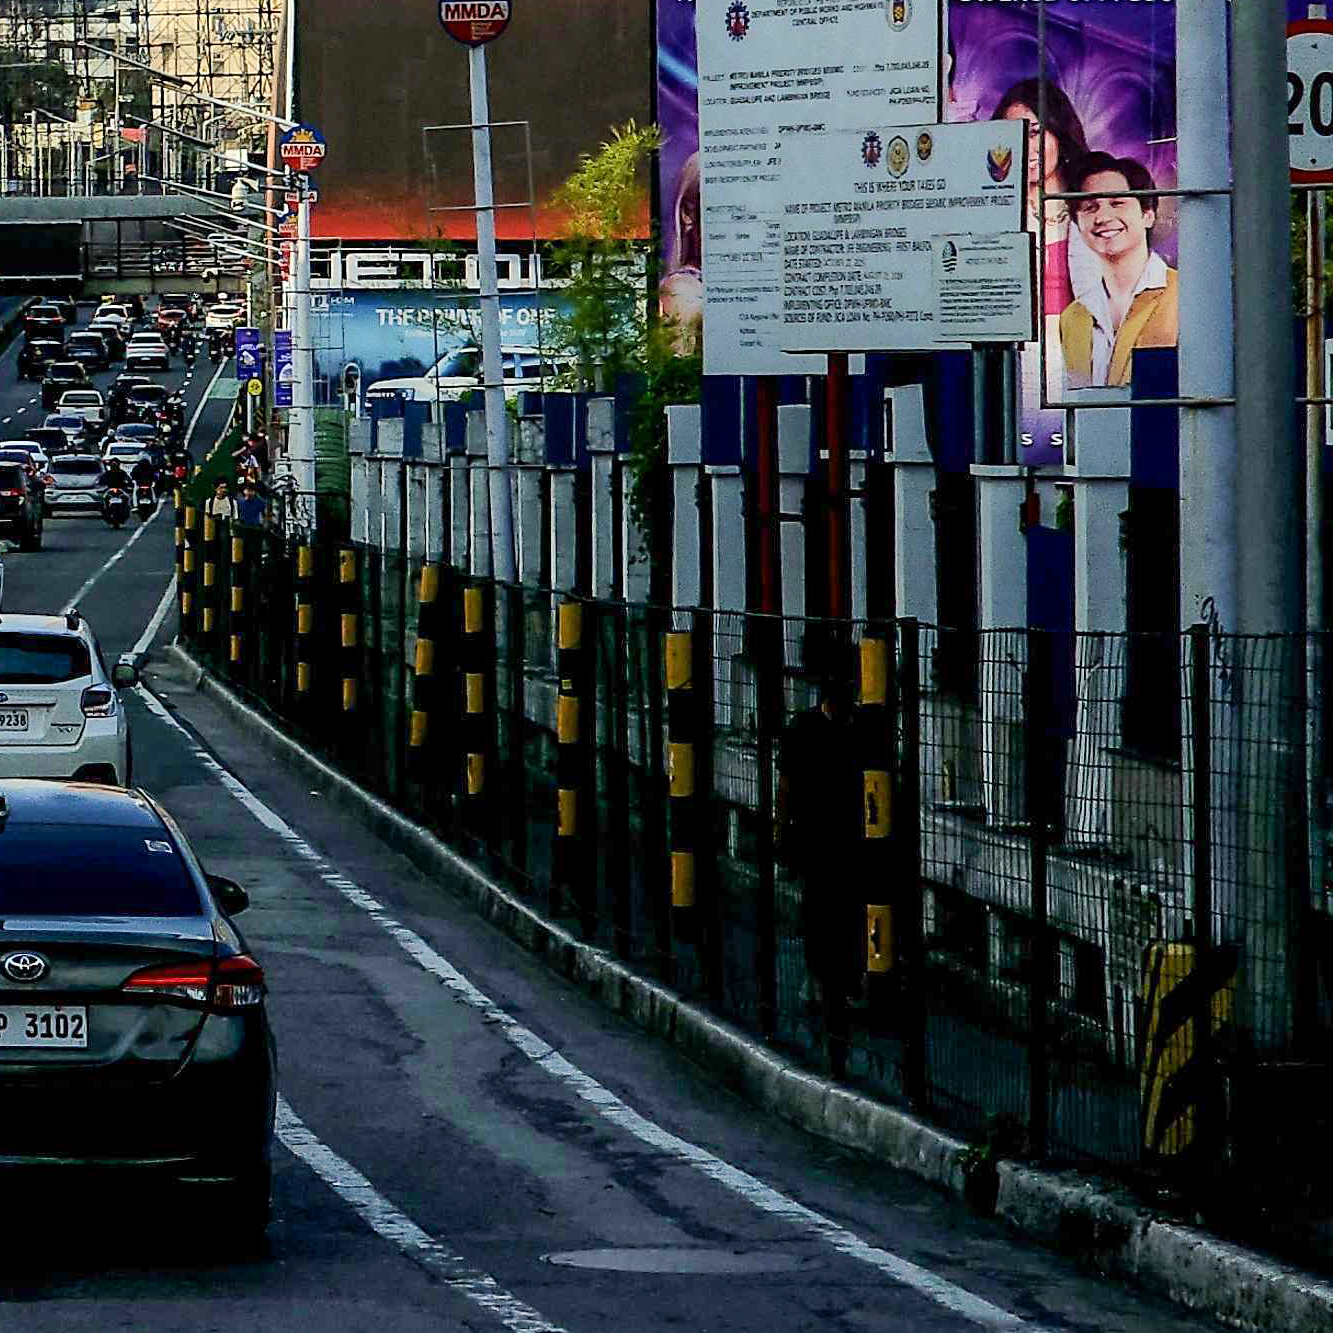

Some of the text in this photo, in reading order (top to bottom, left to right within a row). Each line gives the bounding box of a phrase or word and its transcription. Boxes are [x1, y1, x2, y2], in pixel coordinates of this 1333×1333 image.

[445, 2, 505, 20] MMDA
[283, 145, 321, 157] MMDA
[854, 181, 867, 194] THIS
[876, 181, 897, 193] WHERE
[898, 180, 916, 191] YOUR
[375, 308, 414, 327] THE
[0, 714, 28, 727] 9238
[25, 1012, 85, 1039] 3102
